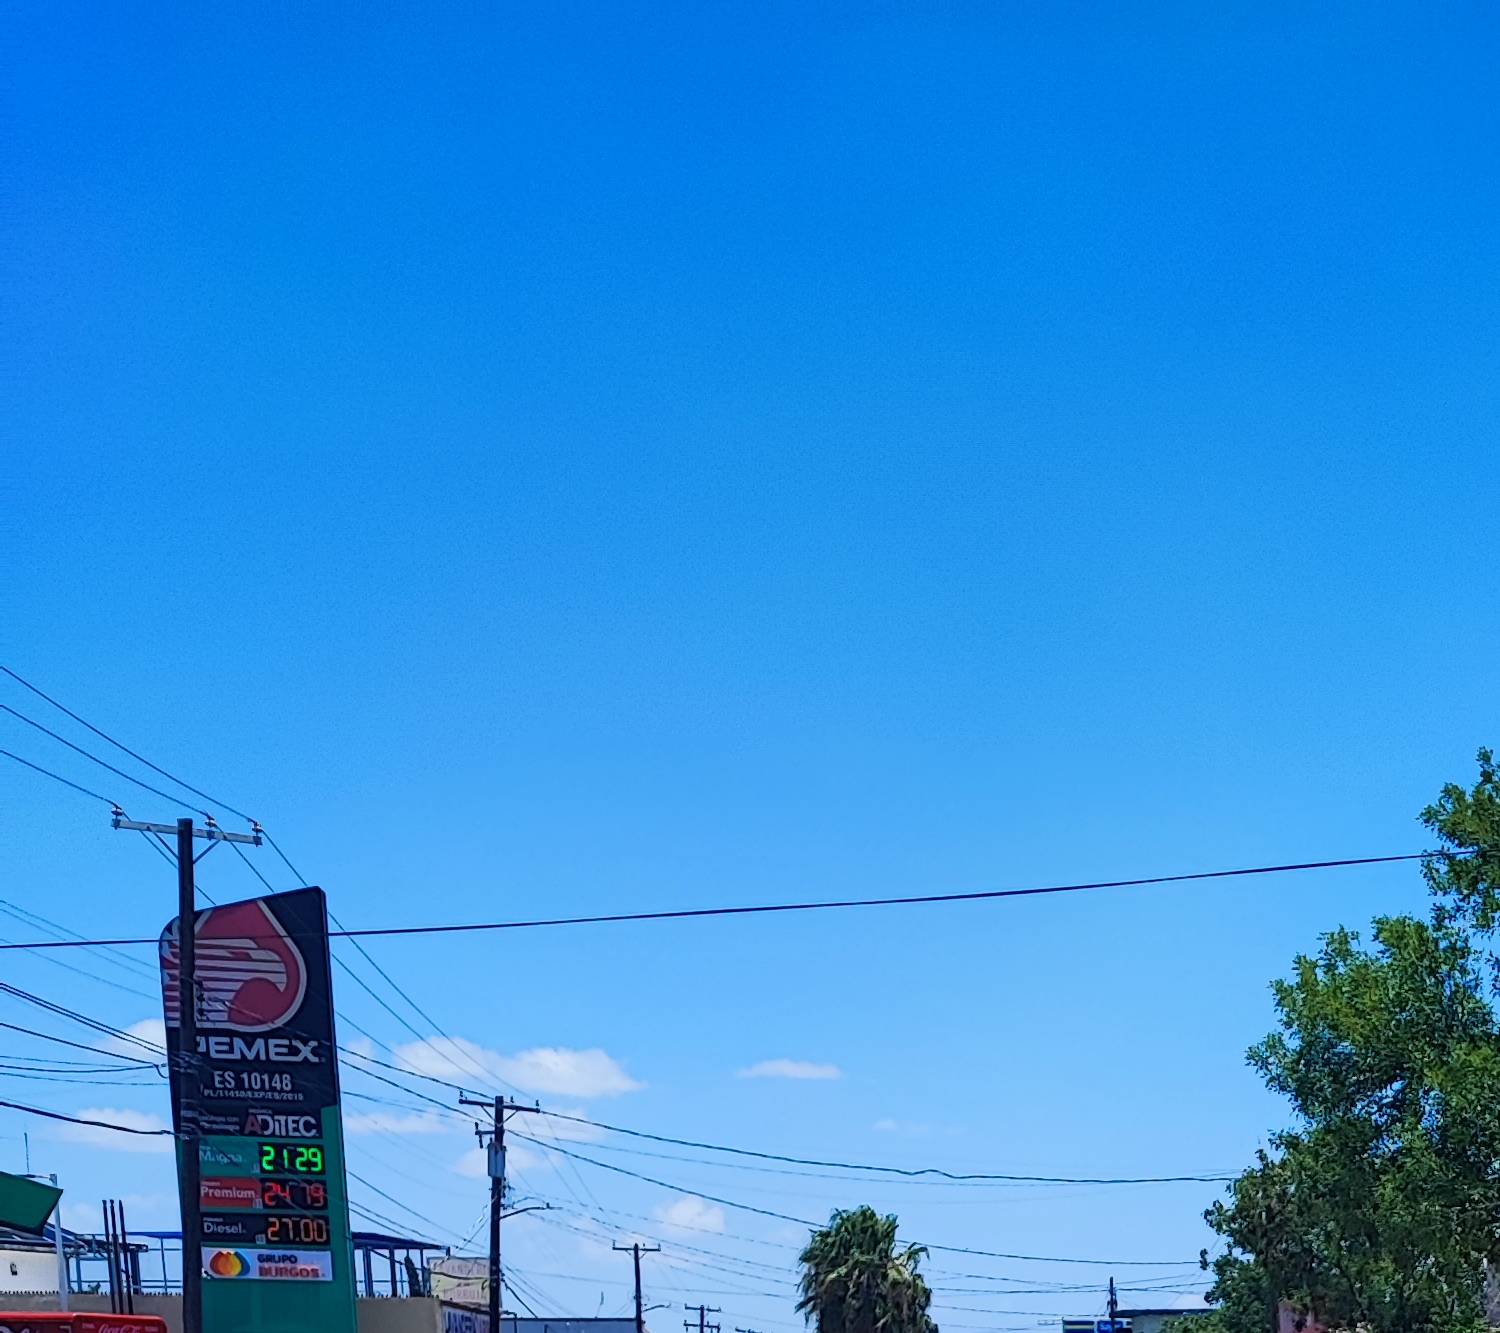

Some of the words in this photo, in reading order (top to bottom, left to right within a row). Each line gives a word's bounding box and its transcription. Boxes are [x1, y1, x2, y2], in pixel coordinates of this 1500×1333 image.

[213, 1071, 235, 1088] ES
[201, 1186, 255, 1198] Premium
[203, 1222, 242, 1234] Diesel
[257, 1253, 298, 1264] GRUPO
[258, 1265, 320, 1278] BURGOS
